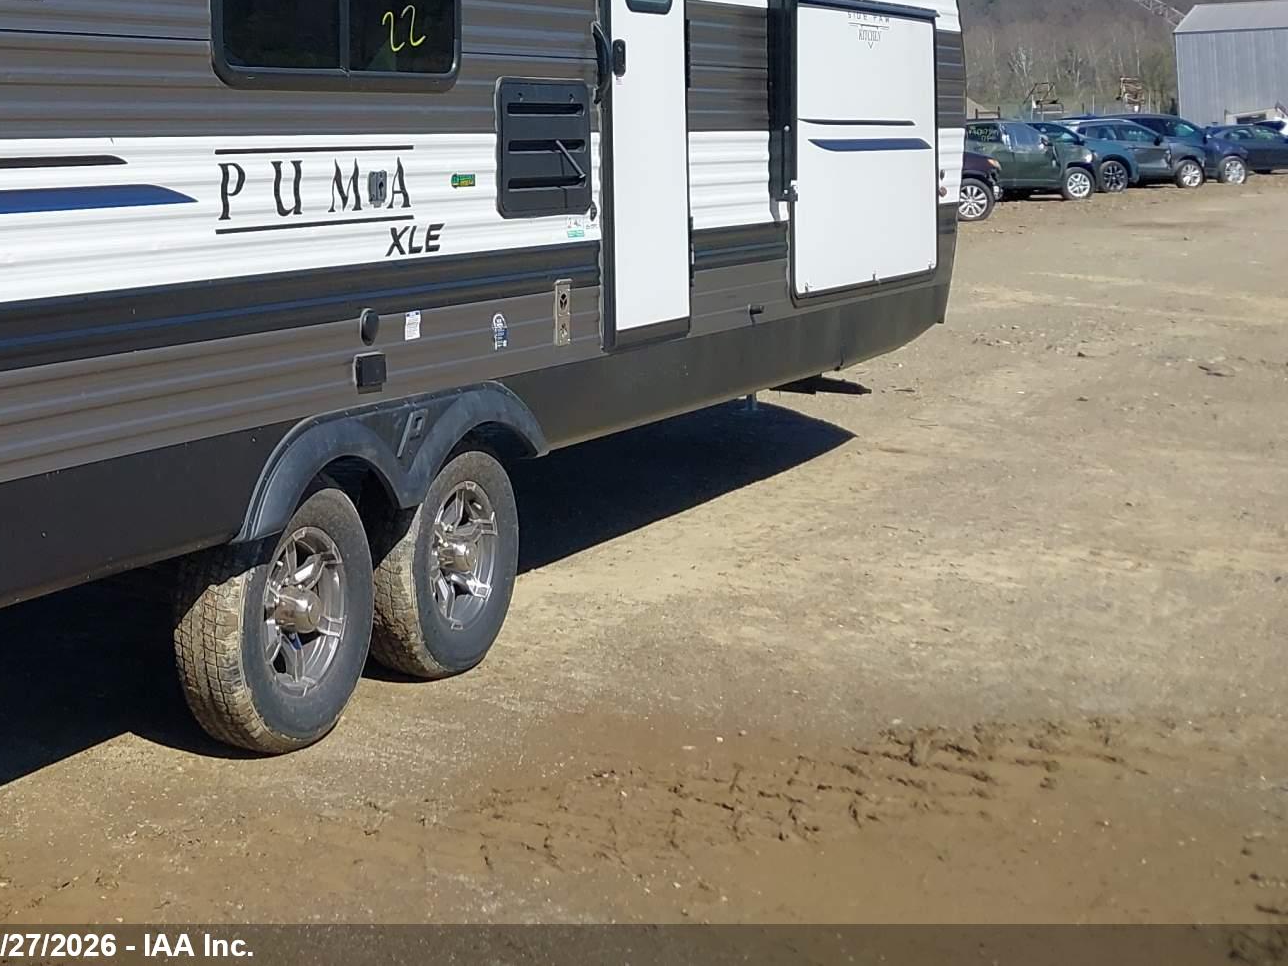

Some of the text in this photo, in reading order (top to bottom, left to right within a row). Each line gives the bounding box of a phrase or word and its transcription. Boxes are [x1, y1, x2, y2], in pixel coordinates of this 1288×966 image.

[381, 4, 427, 52] 22
[217, 156, 412, 221] PUMA
[385, 223, 445, 257] XLE
